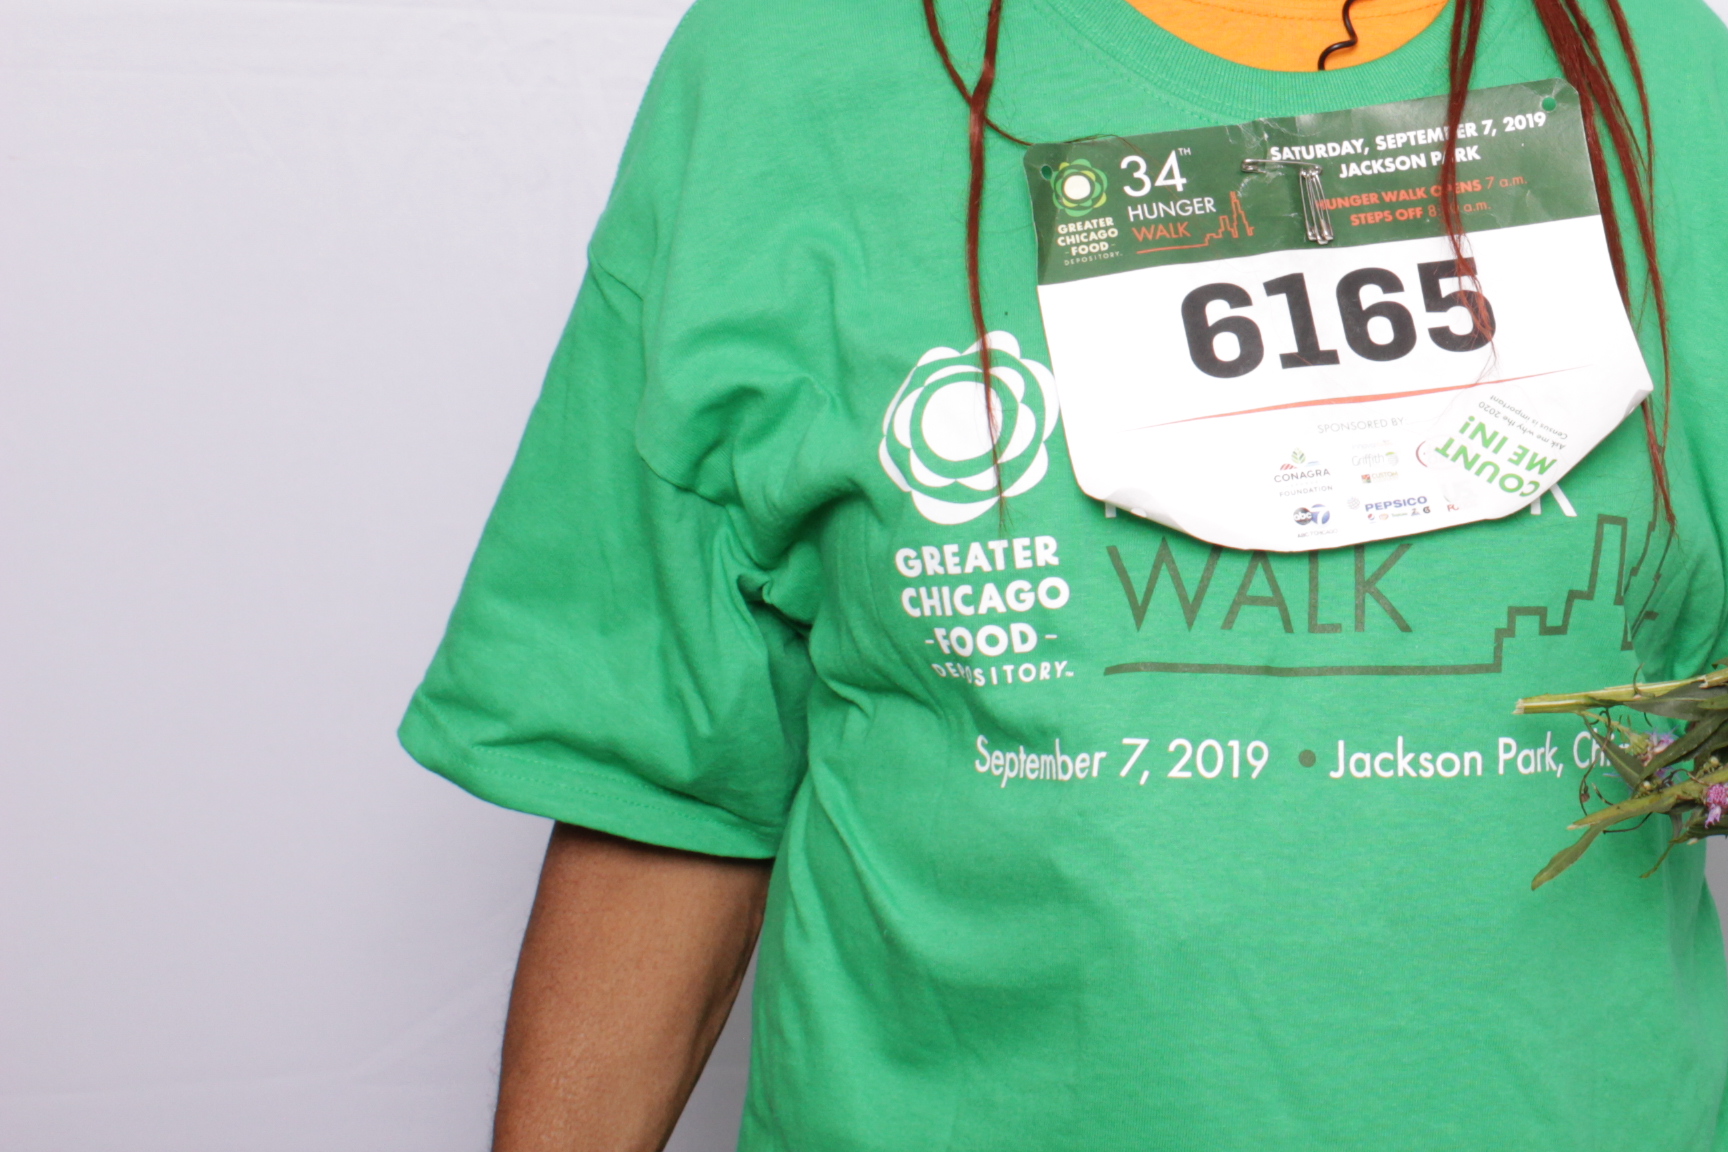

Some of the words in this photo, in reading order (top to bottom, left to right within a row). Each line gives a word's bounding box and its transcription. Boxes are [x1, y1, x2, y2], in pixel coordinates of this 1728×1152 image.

[1270, 138, 1369, 161] SATURDAY,
[1481, 119, 1497, 137] 7,
[1502, 112, 1547, 132] 2019
[1339, 153, 1427, 179] JACKSON
[1430, 145, 1481, 167] PRK
[1381, 186, 1427, 204] WALK
[1430, 179, 1482, 198] OENS
[1485, 176, 1495, 189] 7
[1499, 175, 1528, 188] a.m.
[1127, 197, 1217, 222] HUNGER
[1350, 209, 1393, 227] STEPS
[1395, 206, 1423, 222] OFF
[1463, 201, 1492, 213] a.m.
[1058, 216, 1114, 235] GREATER
[1132, 221, 1192, 242] WALK
[1057, 228, 1119, 247] CHICAGO
[1070, 242, 1109, 256] FOOD
[1181, 256, 1497, 379] 6165
[1478, 401, 1501, 418] 2020
[1490, 394, 1531, 421] important
[1317, 419, 1388, 434] SPONSORED
[1502, 415, 1516, 427] the
[1517, 423, 1534, 436] why
[1532, 418, 1539, 427] is
[1540, 423, 1568, 439] Census
[1458, 415, 1508, 454] IN!
[1536, 434, 1549, 443] me
[1550, 440, 1566, 450] Ask
[1434, 437, 1540, 497] COUNT
[1507, 444, 1557, 475] ME
[1274, 468, 1331, 483] CONAGRA
[1279, 485, 1333, 497] FOUNDATION
[1364, 496, 1428, 512] PEPSICO
[1294, 511, 1312, 521] abc
[895, 535, 1059, 578] GREATER
[1105, 536, 1414, 634] WALK
[901, 576, 1070, 618] CHICAGO
[933, 622, 1038, 657] FOOD
[975, 734, 1107, 788] September
[1119, 738, 1151, 785] 7,
[1167, 738, 1270, 779] 2019
[1329, 735, 1483, 779] Jackson
[1497, 731, 1564, 778] Park,
